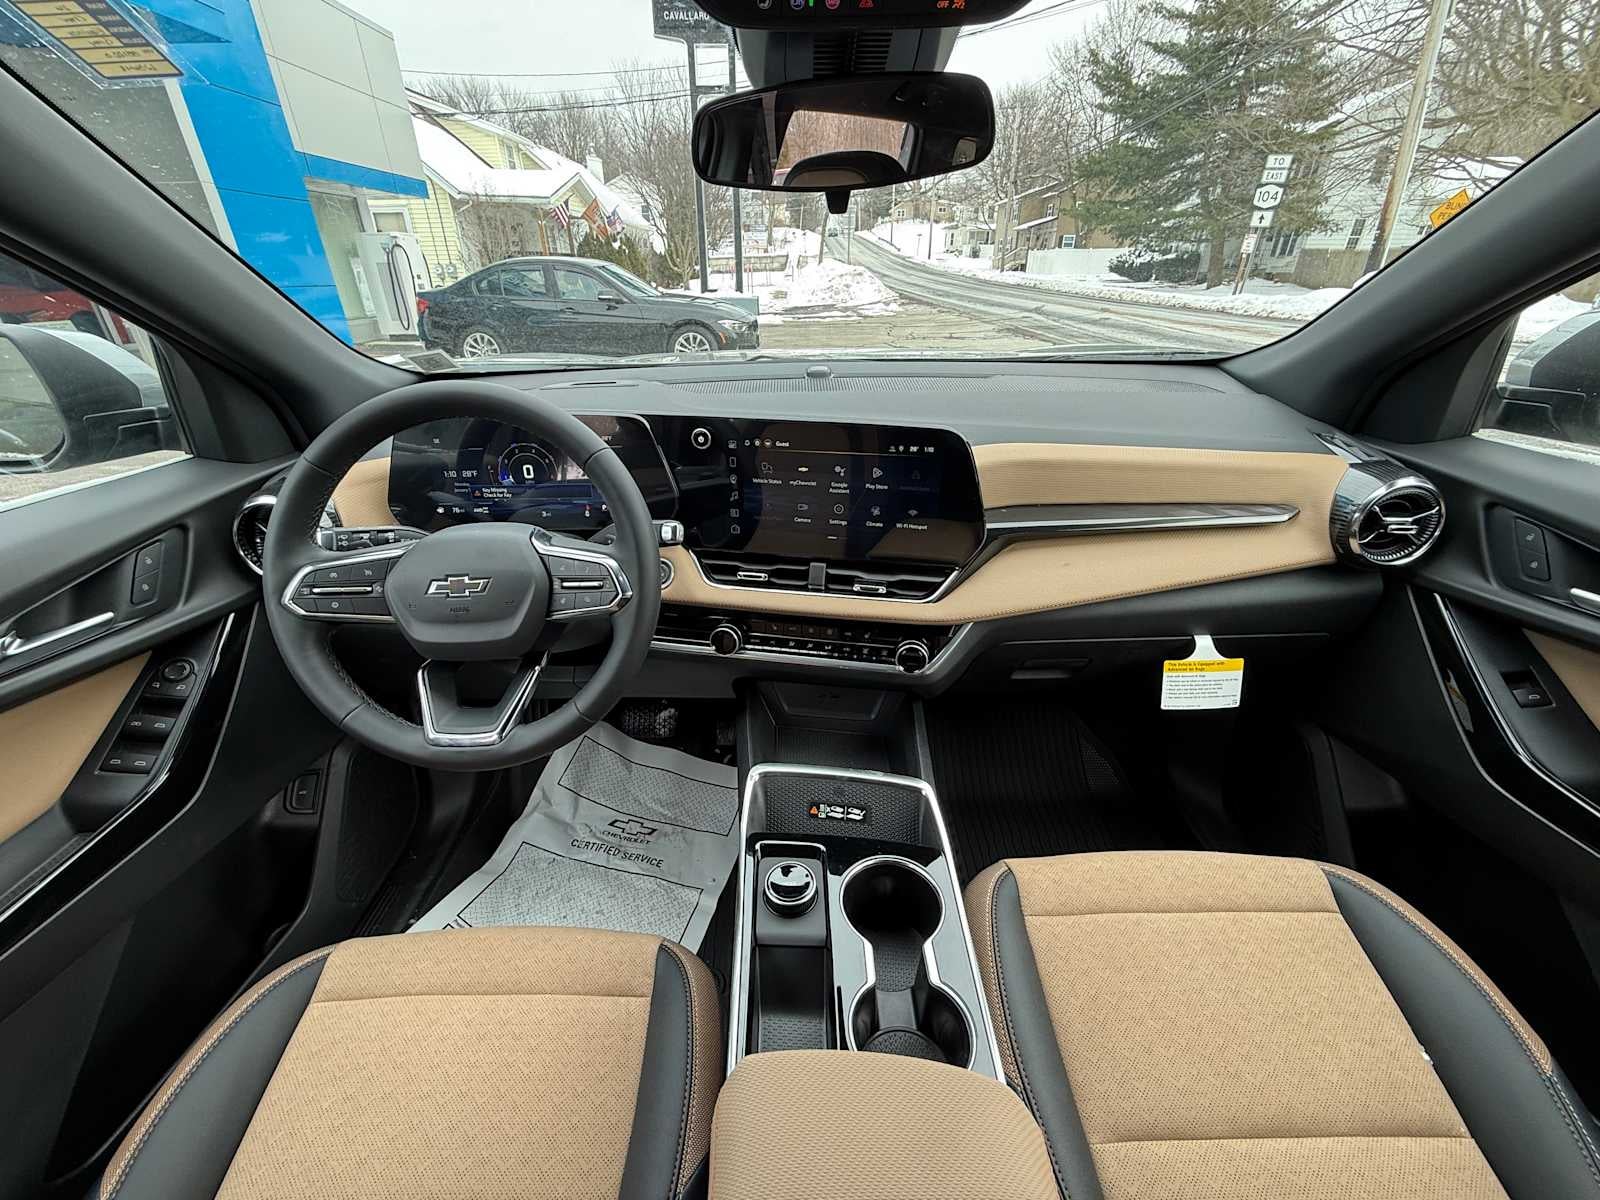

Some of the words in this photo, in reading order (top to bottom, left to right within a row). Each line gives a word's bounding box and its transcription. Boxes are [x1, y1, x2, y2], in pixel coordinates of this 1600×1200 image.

[1273, 157, 1285, 166] TO
[1265, 172, 1283, 181] EAST
[1257, 190, 1279, 203] 104
[522, 464, 535, 480] 0
[601, 830, 651, 845] CHEVROLET
[570, 838, 620, 857] CERTIFIED
[620, 851, 664, 868] SERVICE
